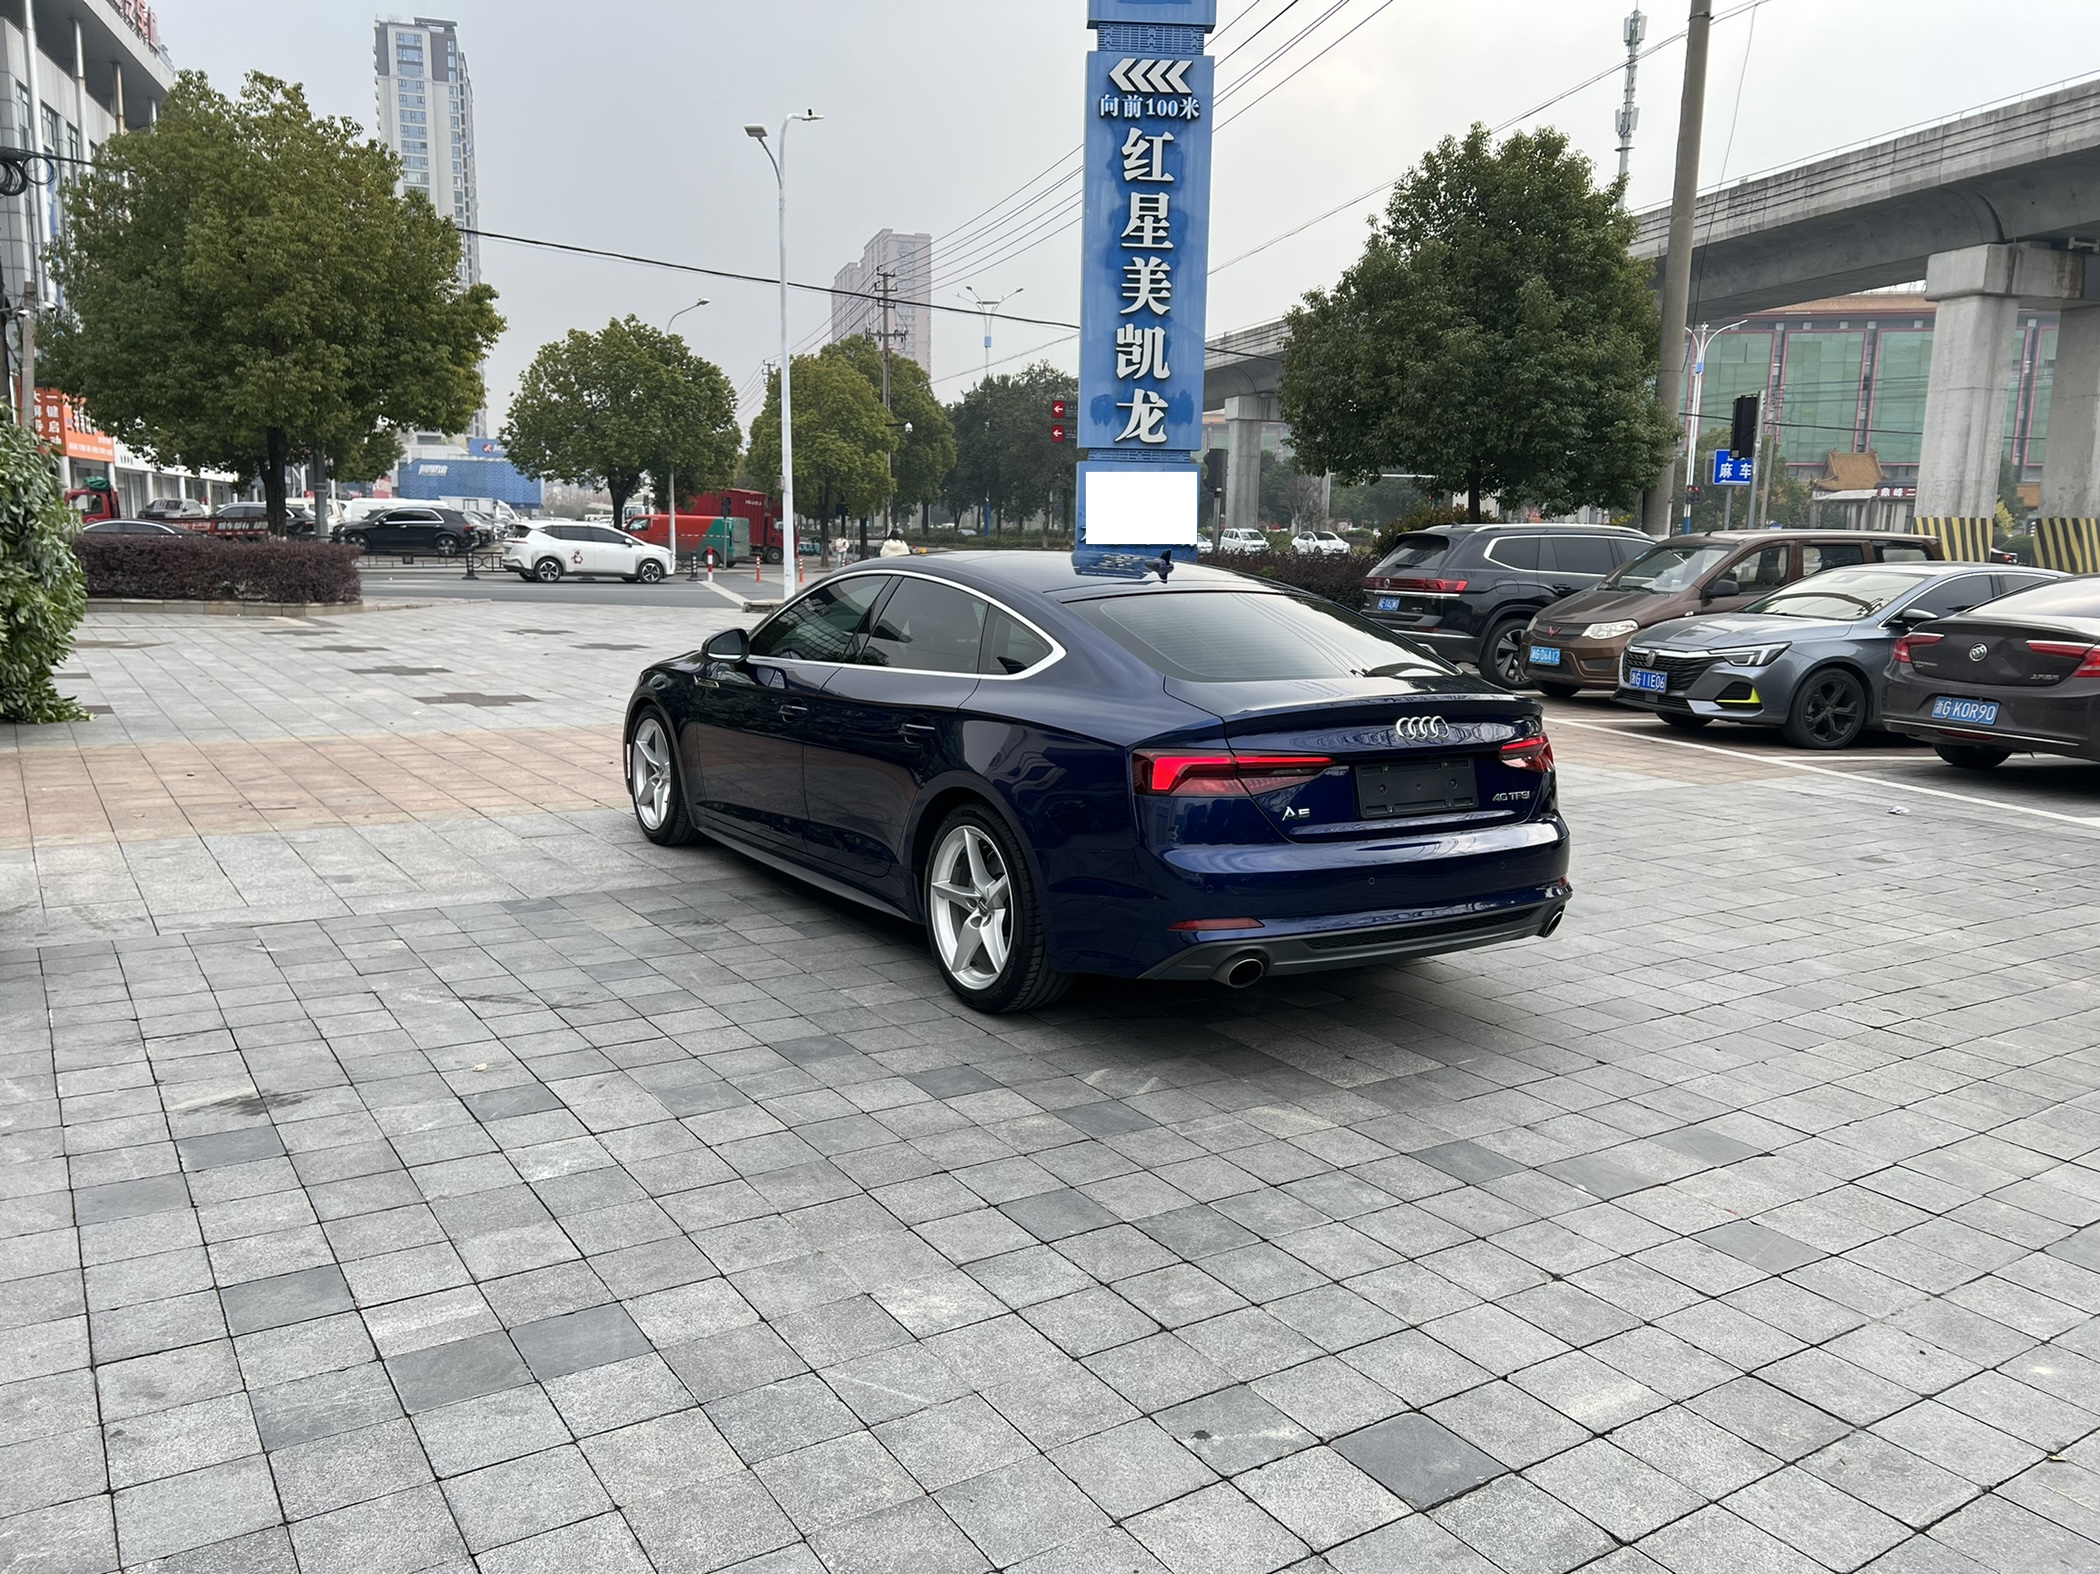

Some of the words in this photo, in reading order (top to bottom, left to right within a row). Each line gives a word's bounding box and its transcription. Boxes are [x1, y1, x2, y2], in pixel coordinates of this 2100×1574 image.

[1099, 94, 1200, 119] 向前100米
[1114, 127, 1175, 443] 红星美凯龙
